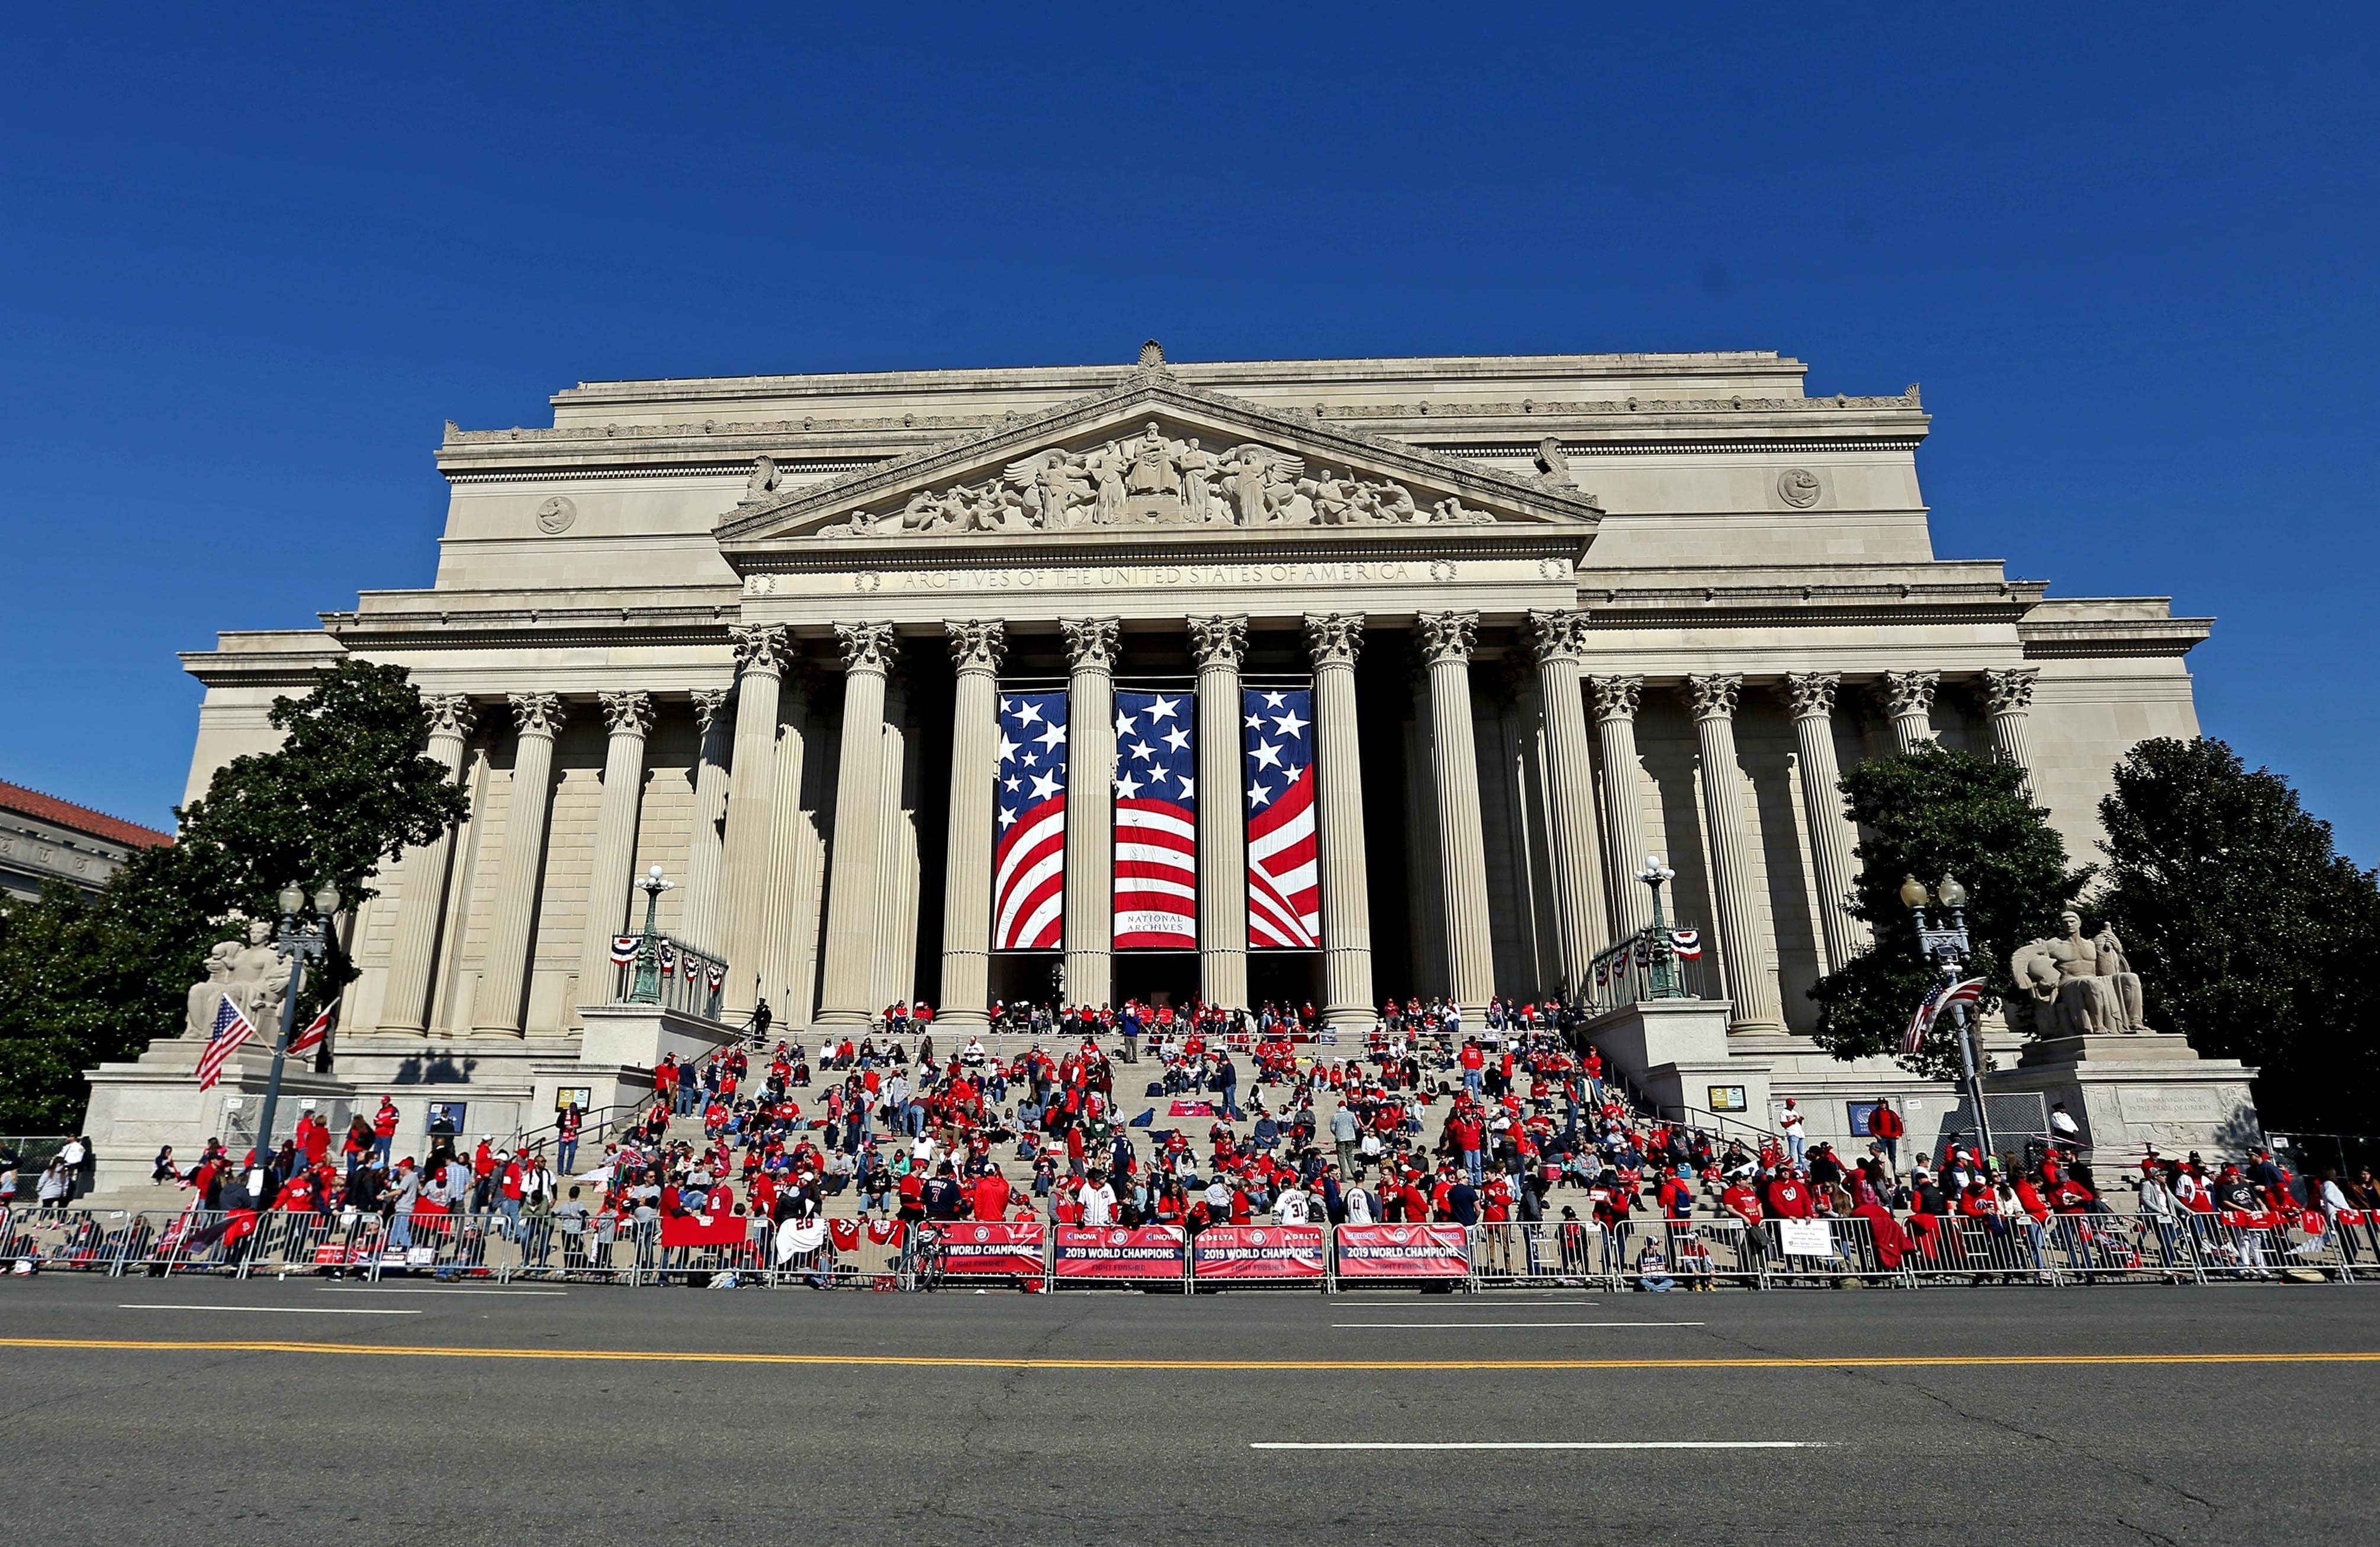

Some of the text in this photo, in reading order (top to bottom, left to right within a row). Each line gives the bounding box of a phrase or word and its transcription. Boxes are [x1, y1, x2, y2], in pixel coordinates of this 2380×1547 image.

[903, 564, 1410, 588] ARCHIVES OF THE UNITED STATES OF AMERICA
[1127, 915, 1183, 923] NATIONAL
[931, 1188, 941, 1202] 7
[1291, 1202, 1303, 1218] 31
[795, 1217, 813, 1230] 28
[837, 1219, 855, 1236] 37
[950, 1244, 1034, 1255] WORLD CHAMPIONS
[1065, 1247, 1175, 1259] 2019 WORLD CHAMPIONS
[1204, 1247, 1314, 1259] 2019 WORLD CHAMPIONS
[1347, 1247, 1458, 1257] 2019 WORLD CHAMPIONS
